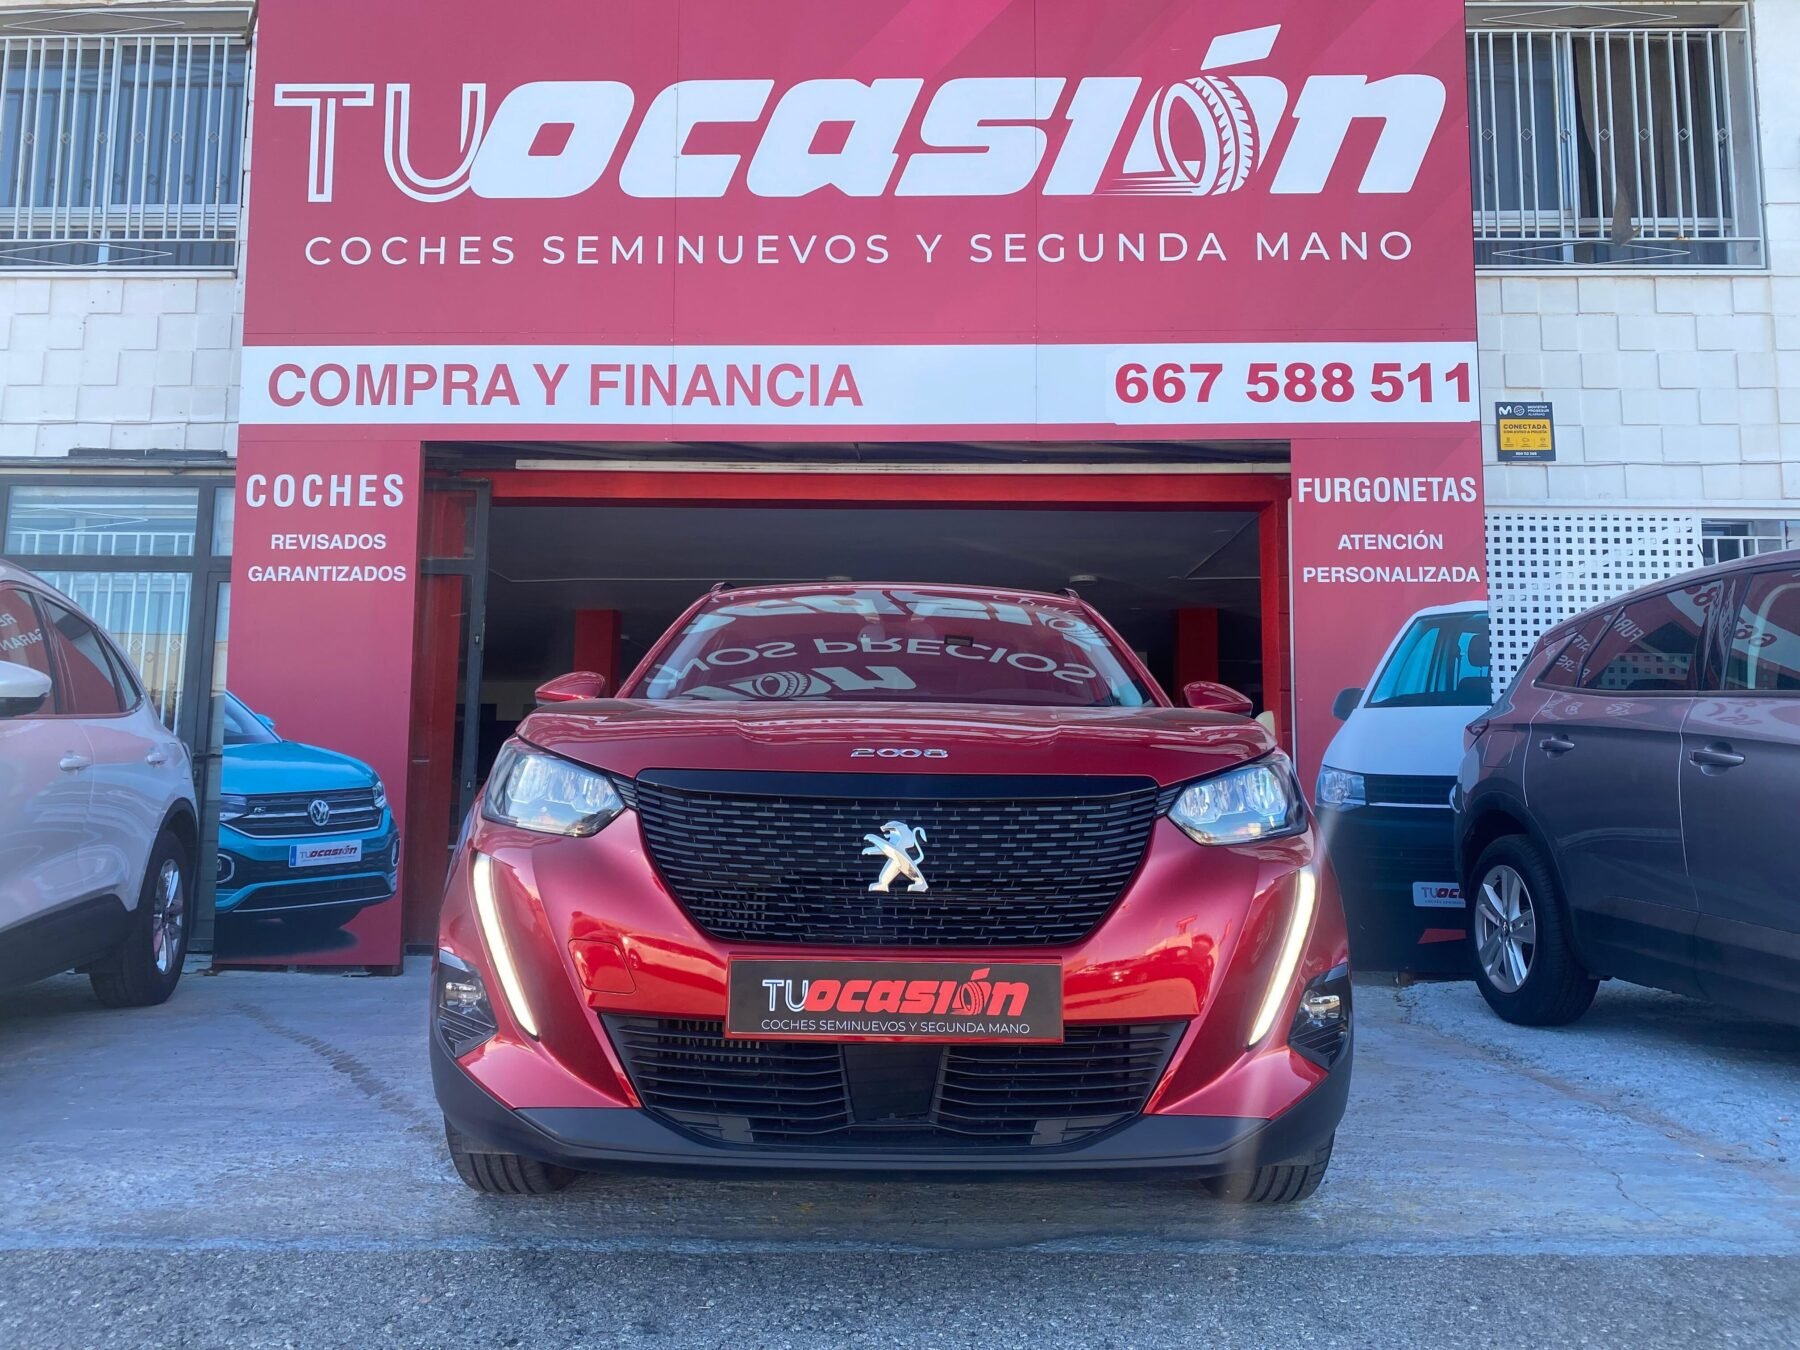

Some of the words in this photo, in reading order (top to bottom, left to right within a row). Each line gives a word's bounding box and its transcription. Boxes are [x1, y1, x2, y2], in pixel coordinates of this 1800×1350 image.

[305, 236, 515, 267] COCHES
[542, 235, 890, 266] SEMINUEVOS
[917, 235, 943, 264] Y
[970, 233, 1228, 264] SEGUNDA
[1257, 231, 1413, 262] MANO
[268, 364, 520, 408] COMPRA
[534, 364, 571, 407] Y
[590, 364, 864, 408] FINANCIA
[1116, 363, 1224, 405] 667
[1247, 363, 1356, 404] 588
[1371, 363, 1471, 404] 511
[246, 474, 405, 508] COCHES
[1298, 477, 1477, 504] FURGONETAS
[271, 534, 387, 551] REVISADOS
[1338, 530, 1444, 551] ATENCIÓN
[248, 566, 407, 582] GARANTIZADOS
[1303, 567, 1481, 584] PERSONALIZADA
[850, 748, 949, 758] 2008
[761, 1019, 816, 1031] COCHES
[819, 1020, 906, 1032] SEMINUEVOS
[909, 1021, 918, 1032] Y
[920, 1021, 986, 1033] SEGUNDA
[988, 1023, 1030, 1034] MANO
